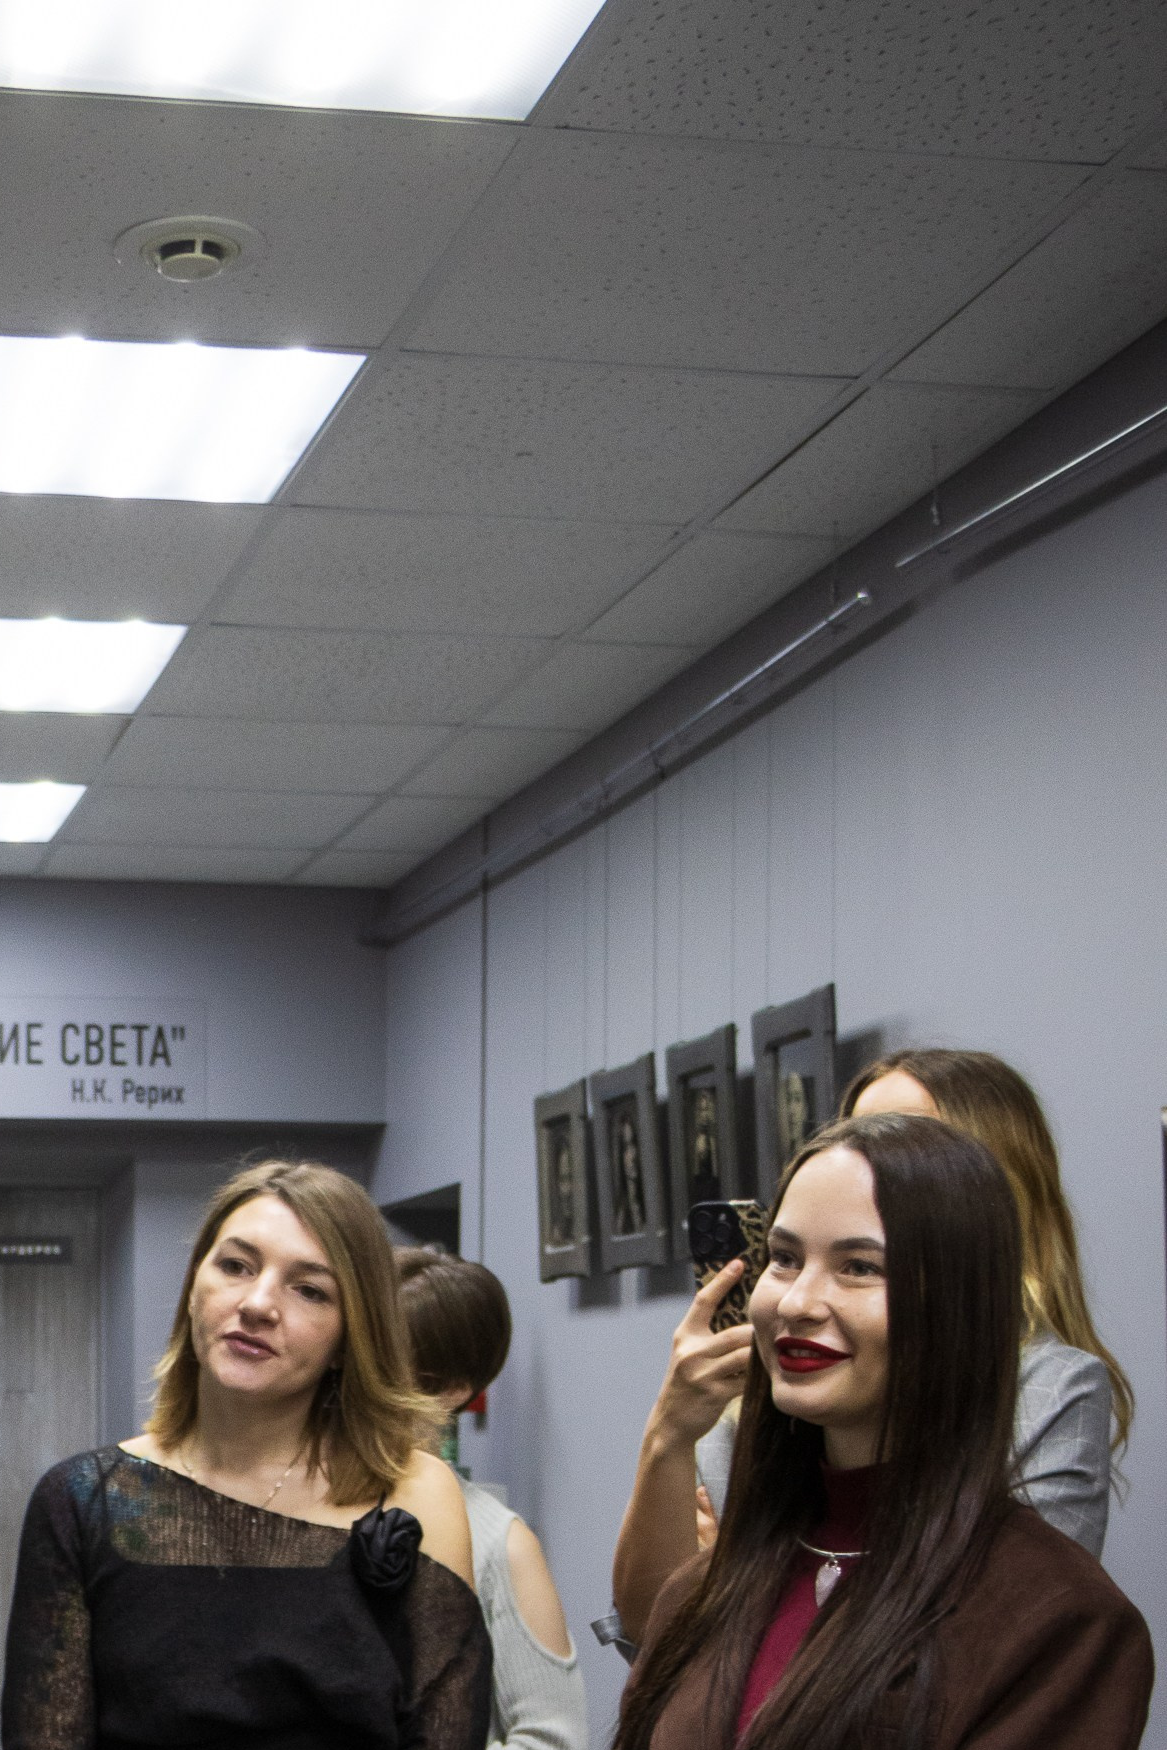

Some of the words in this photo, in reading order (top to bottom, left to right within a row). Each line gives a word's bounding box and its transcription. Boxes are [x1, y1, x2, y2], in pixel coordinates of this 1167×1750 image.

[61, 1023, 186, 1067] СВЕТА"
[71, 1078, 113, 1103] Н.К.
[122, 1077, 185, 1110] Рерих
